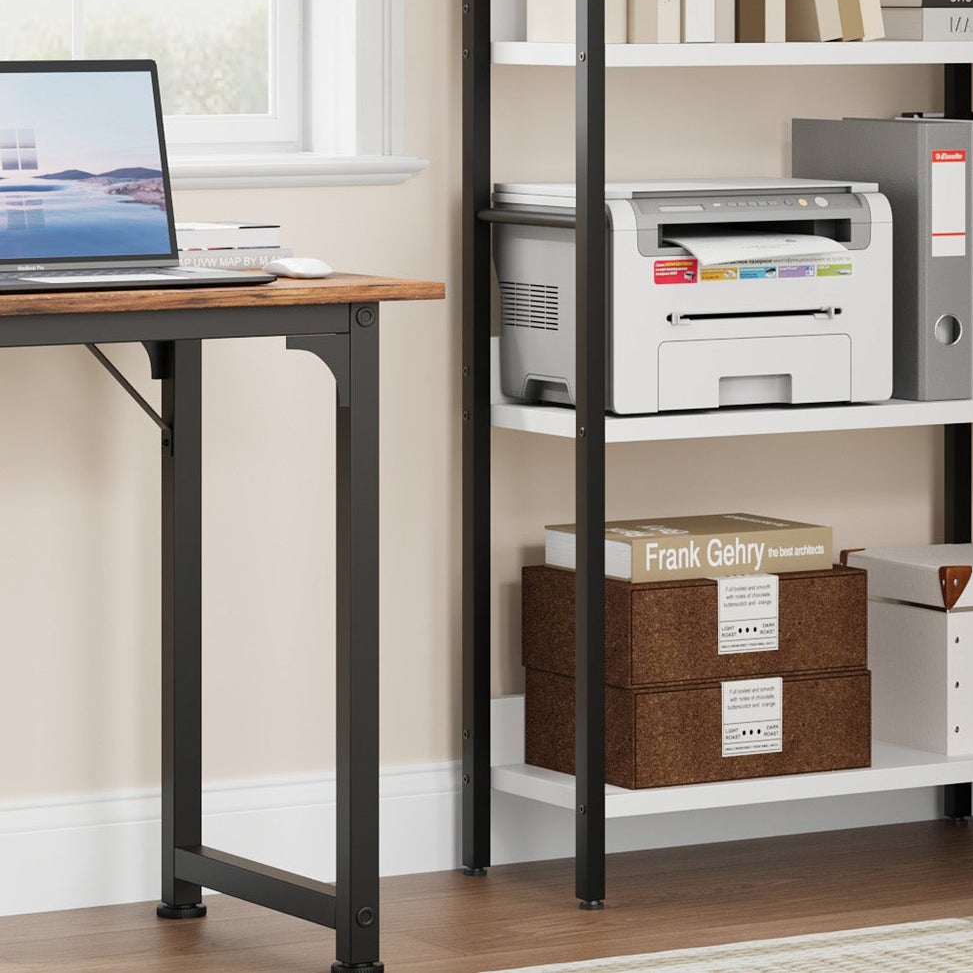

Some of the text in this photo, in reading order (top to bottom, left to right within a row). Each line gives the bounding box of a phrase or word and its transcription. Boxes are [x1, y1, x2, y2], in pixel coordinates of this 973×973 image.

[194, 257, 257, 267] UVW MAP BY
[646, 537, 825, 571] Frank Gehry the best architects
